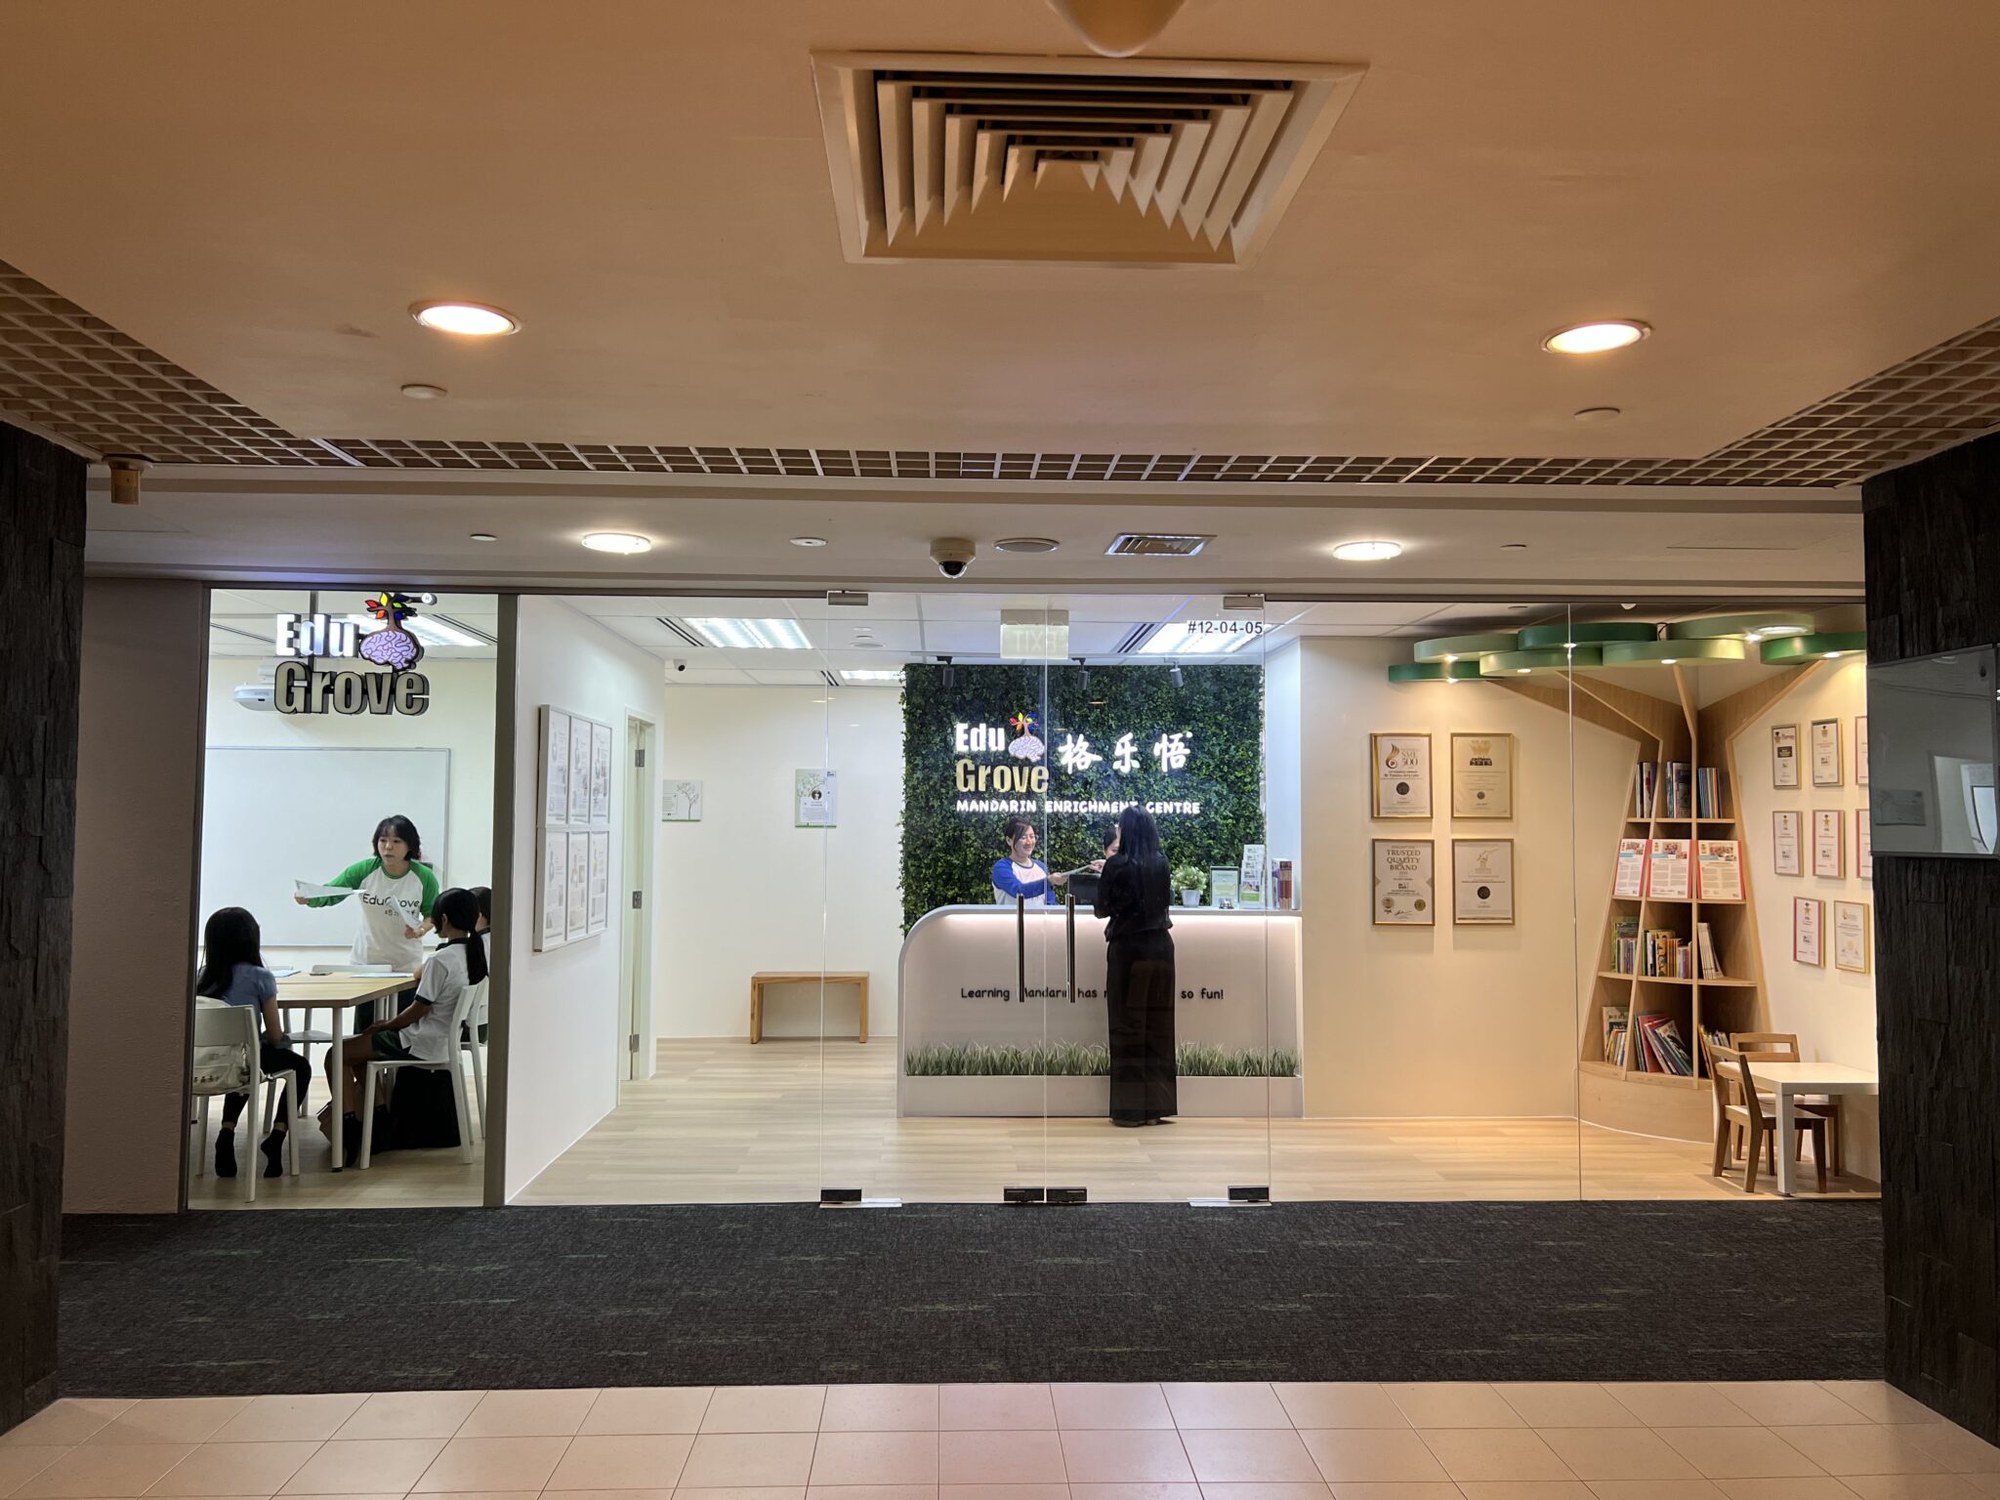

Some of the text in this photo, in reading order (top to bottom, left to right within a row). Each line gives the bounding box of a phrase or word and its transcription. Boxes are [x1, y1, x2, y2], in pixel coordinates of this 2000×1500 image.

[276, 613, 357, 657] Edu
[1188, 620, 1263, 634] #12-04-05
[274, 661, 429, 715] Grove
[955, 722, 1005, 751] Edu
[1058, 731, 1194, 775] 格乐悟
[956, 759, 1049, 793] Grove
[956, 800, 1037, 812] MANDARIN
[1145, 802, 1201, 814] CENTRE
[1386, 856, 1420, 864] QUALITY
[961, 988, 1010, 1001] Learning
[1077, 988, 1098, 998] has
[1180, 990, 1194, 999] so
[1201, 987, 1224, 1000] fun!
